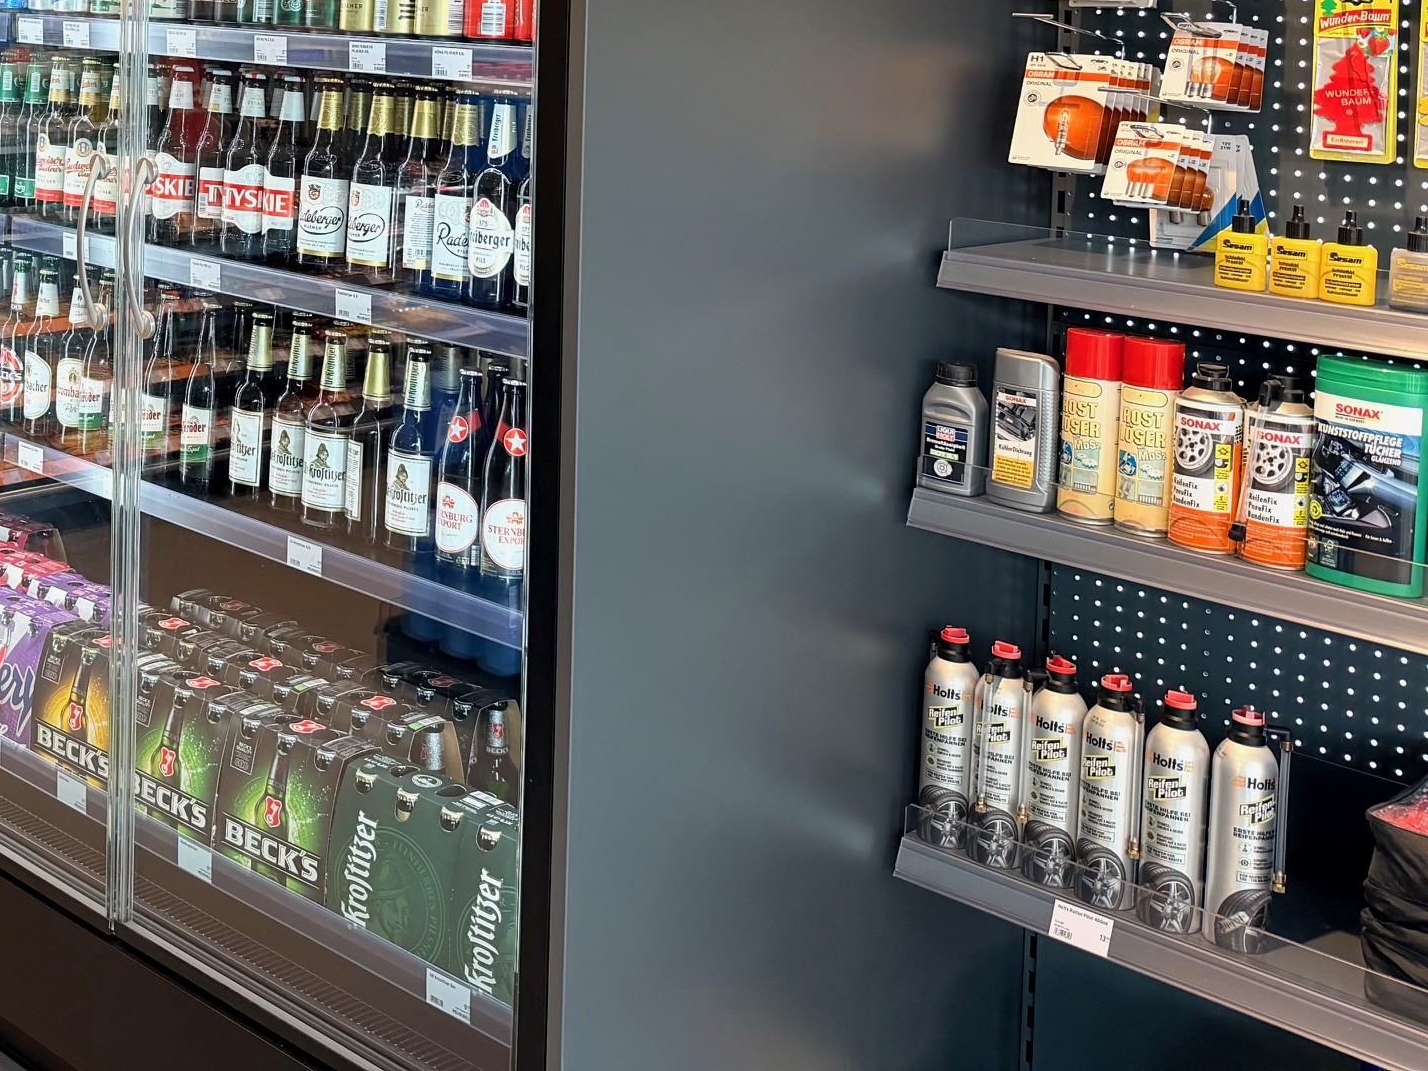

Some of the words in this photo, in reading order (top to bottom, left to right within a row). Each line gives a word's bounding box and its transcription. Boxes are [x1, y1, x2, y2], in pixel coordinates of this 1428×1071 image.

[1319, 11, 1391, 30] Wunder-Baum
[1173, 37, 1203, 46] OSRAM
[1030, 55, 1045, 63] H1
[1027, 70, 1055, 79] OSRAM
[1341, 97, 1372, 106] BAUM
[1117, 138, 1145, 148] OSRAM
[1330, 136, 1365, 146] Erdbeeren
[155, 176, 194, 197] SKIE
[263, 192, 288, 213] KIE
[1223, 239, 1253, 252] Sesam
[1276, 245, 1307, 258] Sesam
[1330, 252, 1363, 265] Sesam
[25, 381, 48, 394] bacher
[1005, 395, 1027, 404] SONAX
[1122, 406, 1164, 429] ROST
[1335, 403, 1381, 420] SONAX
[1063, 415, 1102, 438] ÖSER
[1180, 416, 1221, 432] SONAX
[1257, 430, 1301, 445] SONAX
[1318, 422, 1404, 449] KUNSTSTOFFPFLEGE
[1364, 441, 1402, 459] TÜCHER
[1370, 454, 1402, 467] GLÄNZEND
[933, 684, 961, 701] Holts
[928, 707, 957, 719] Reifen
[938, 715, 962, 726] Pilot
[1036, 717, 1065, 734] Holts
[1031, 740, 1060, 751] Reifen
[1086, 732, 1113, 751] Holts
[37, 723, 110, 778] BECK'S
[1041, 748, 1066, 760] Pilot
[1083, 757, 1108, 769] Reifen
[1152, 752, 1184, 772] Holts
[1089, 766, 1114, 777] Pilot
[1148, 778, 1179, 790] Reifen
[1247, 778, 1275, 791] Holts
[1158, 787, 1184, 798] Pilot
[225, 817, 319, 883] BECK'S
